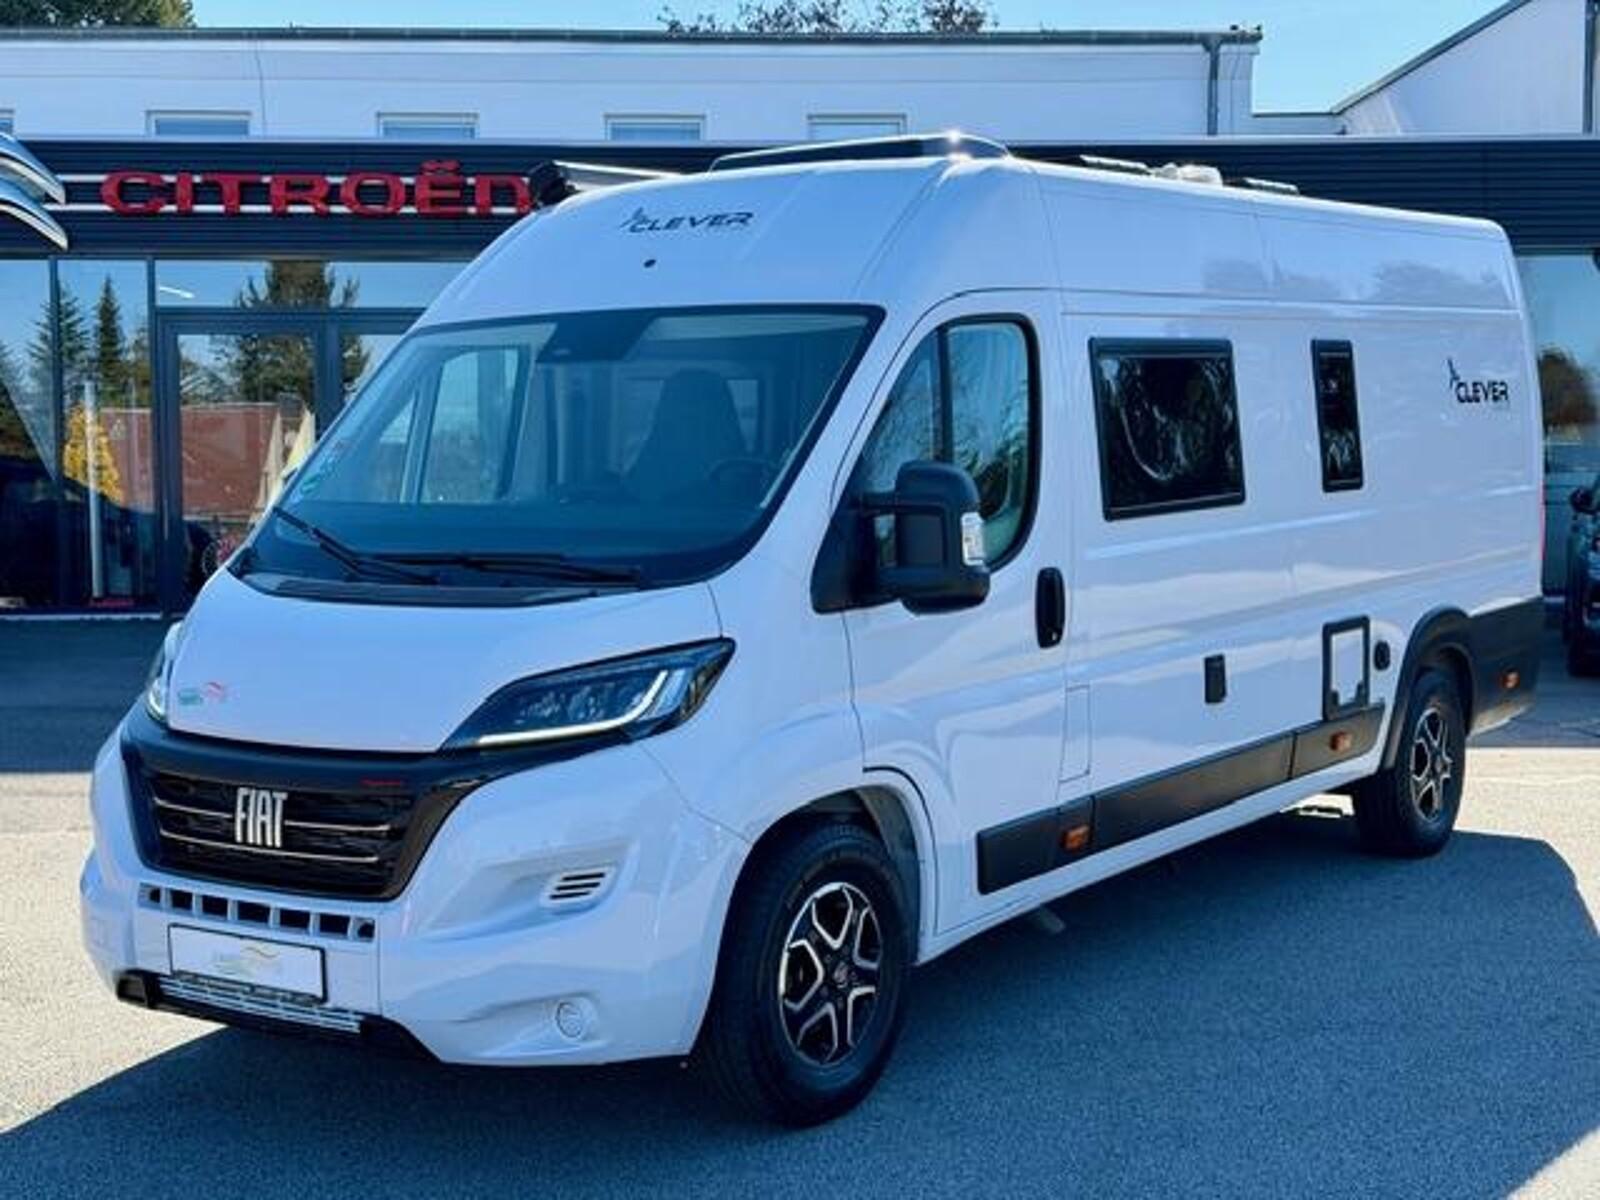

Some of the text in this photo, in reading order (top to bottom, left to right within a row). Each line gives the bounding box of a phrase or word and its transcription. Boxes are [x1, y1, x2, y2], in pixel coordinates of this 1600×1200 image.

[629, 211, 754, 233] CLEVER
[1456, 381, 1509, 403] CLEVER
[234, 786, 289, 848] FIAT
